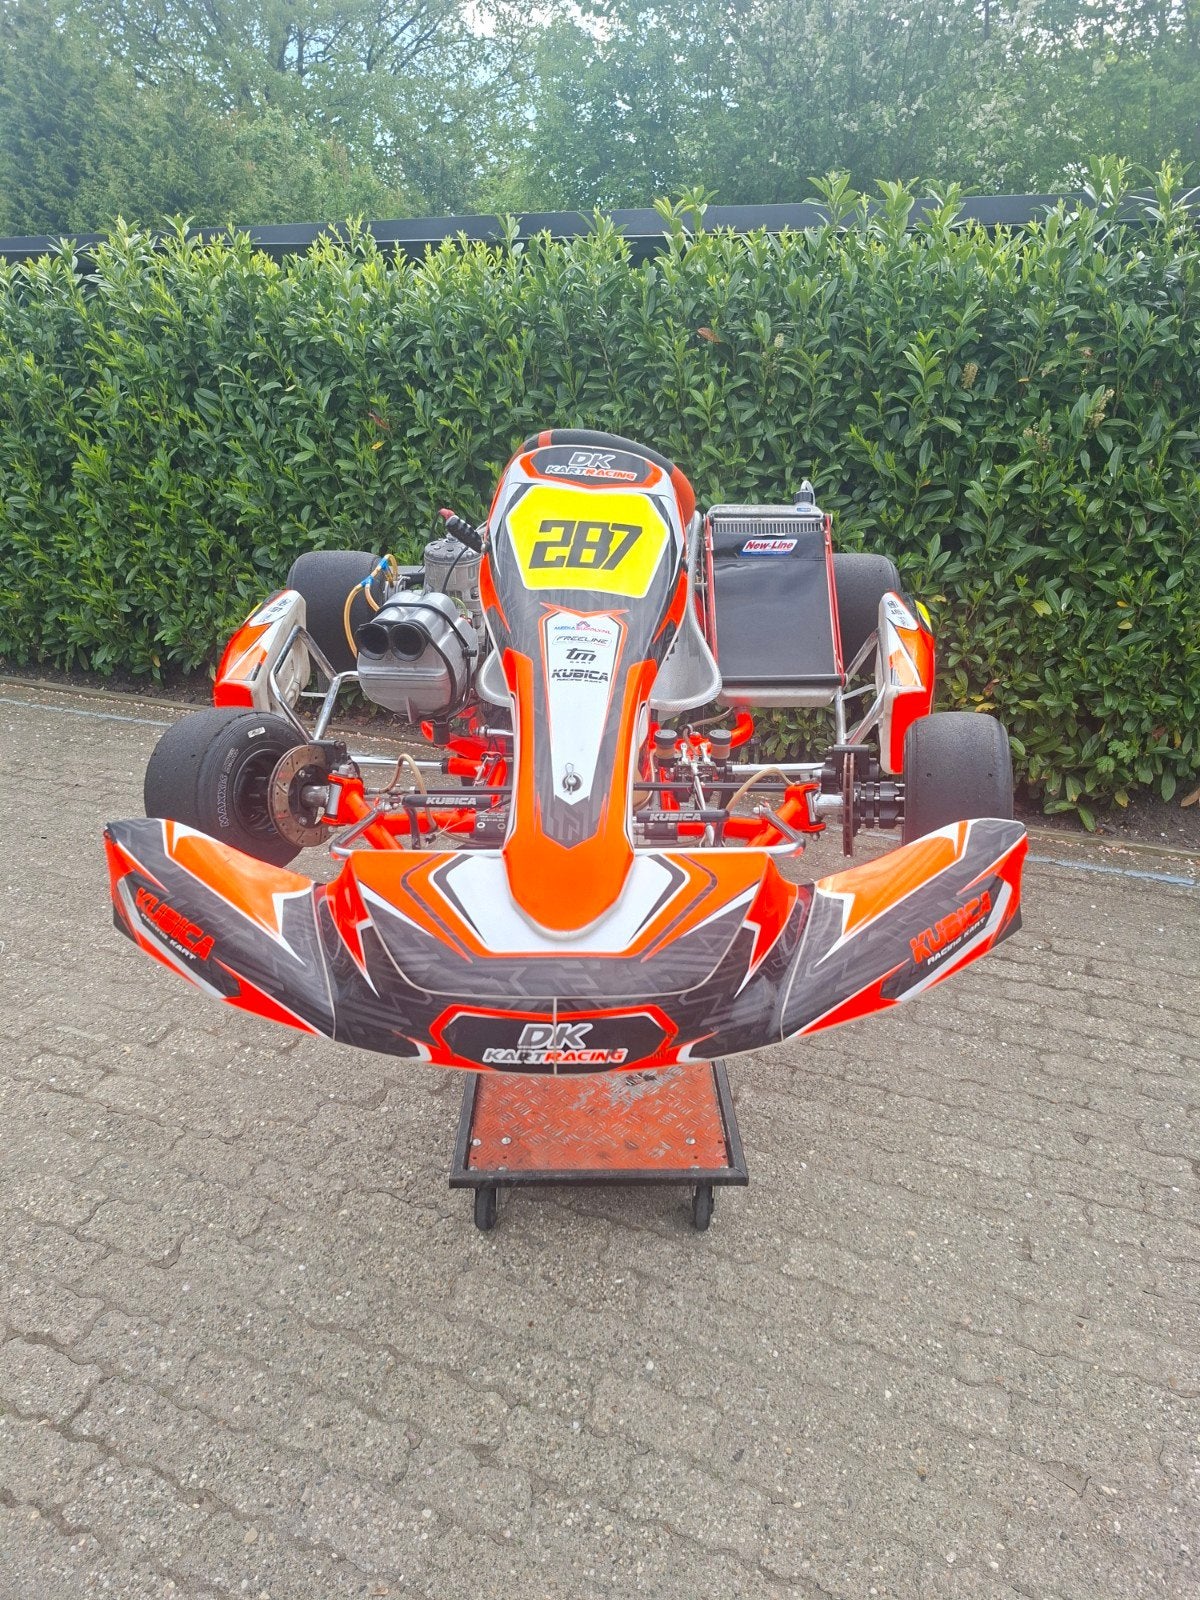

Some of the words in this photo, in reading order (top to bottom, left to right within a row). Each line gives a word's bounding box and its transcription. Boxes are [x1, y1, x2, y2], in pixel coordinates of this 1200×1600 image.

[568, 452, 616, 469] DK
[545, 465, 637, 481] KARTRACING
[529, 520, 643, 570] 287
[557, 635, 608, 644] FREELINE
[551, 668, 609, 682] KUBICA
[216, 774, 230, 828] MAXXIS
[425, 797, 477, 805] KUBICA
[649, 813, 702, 822] KUBICA
[135, 887, 215, 961] KUBICA
[909, 890, 992, 965] KUBICA
[517, 1023, 593, 1049] DK
[482, 1047, 629, 1064] KARTRACING
